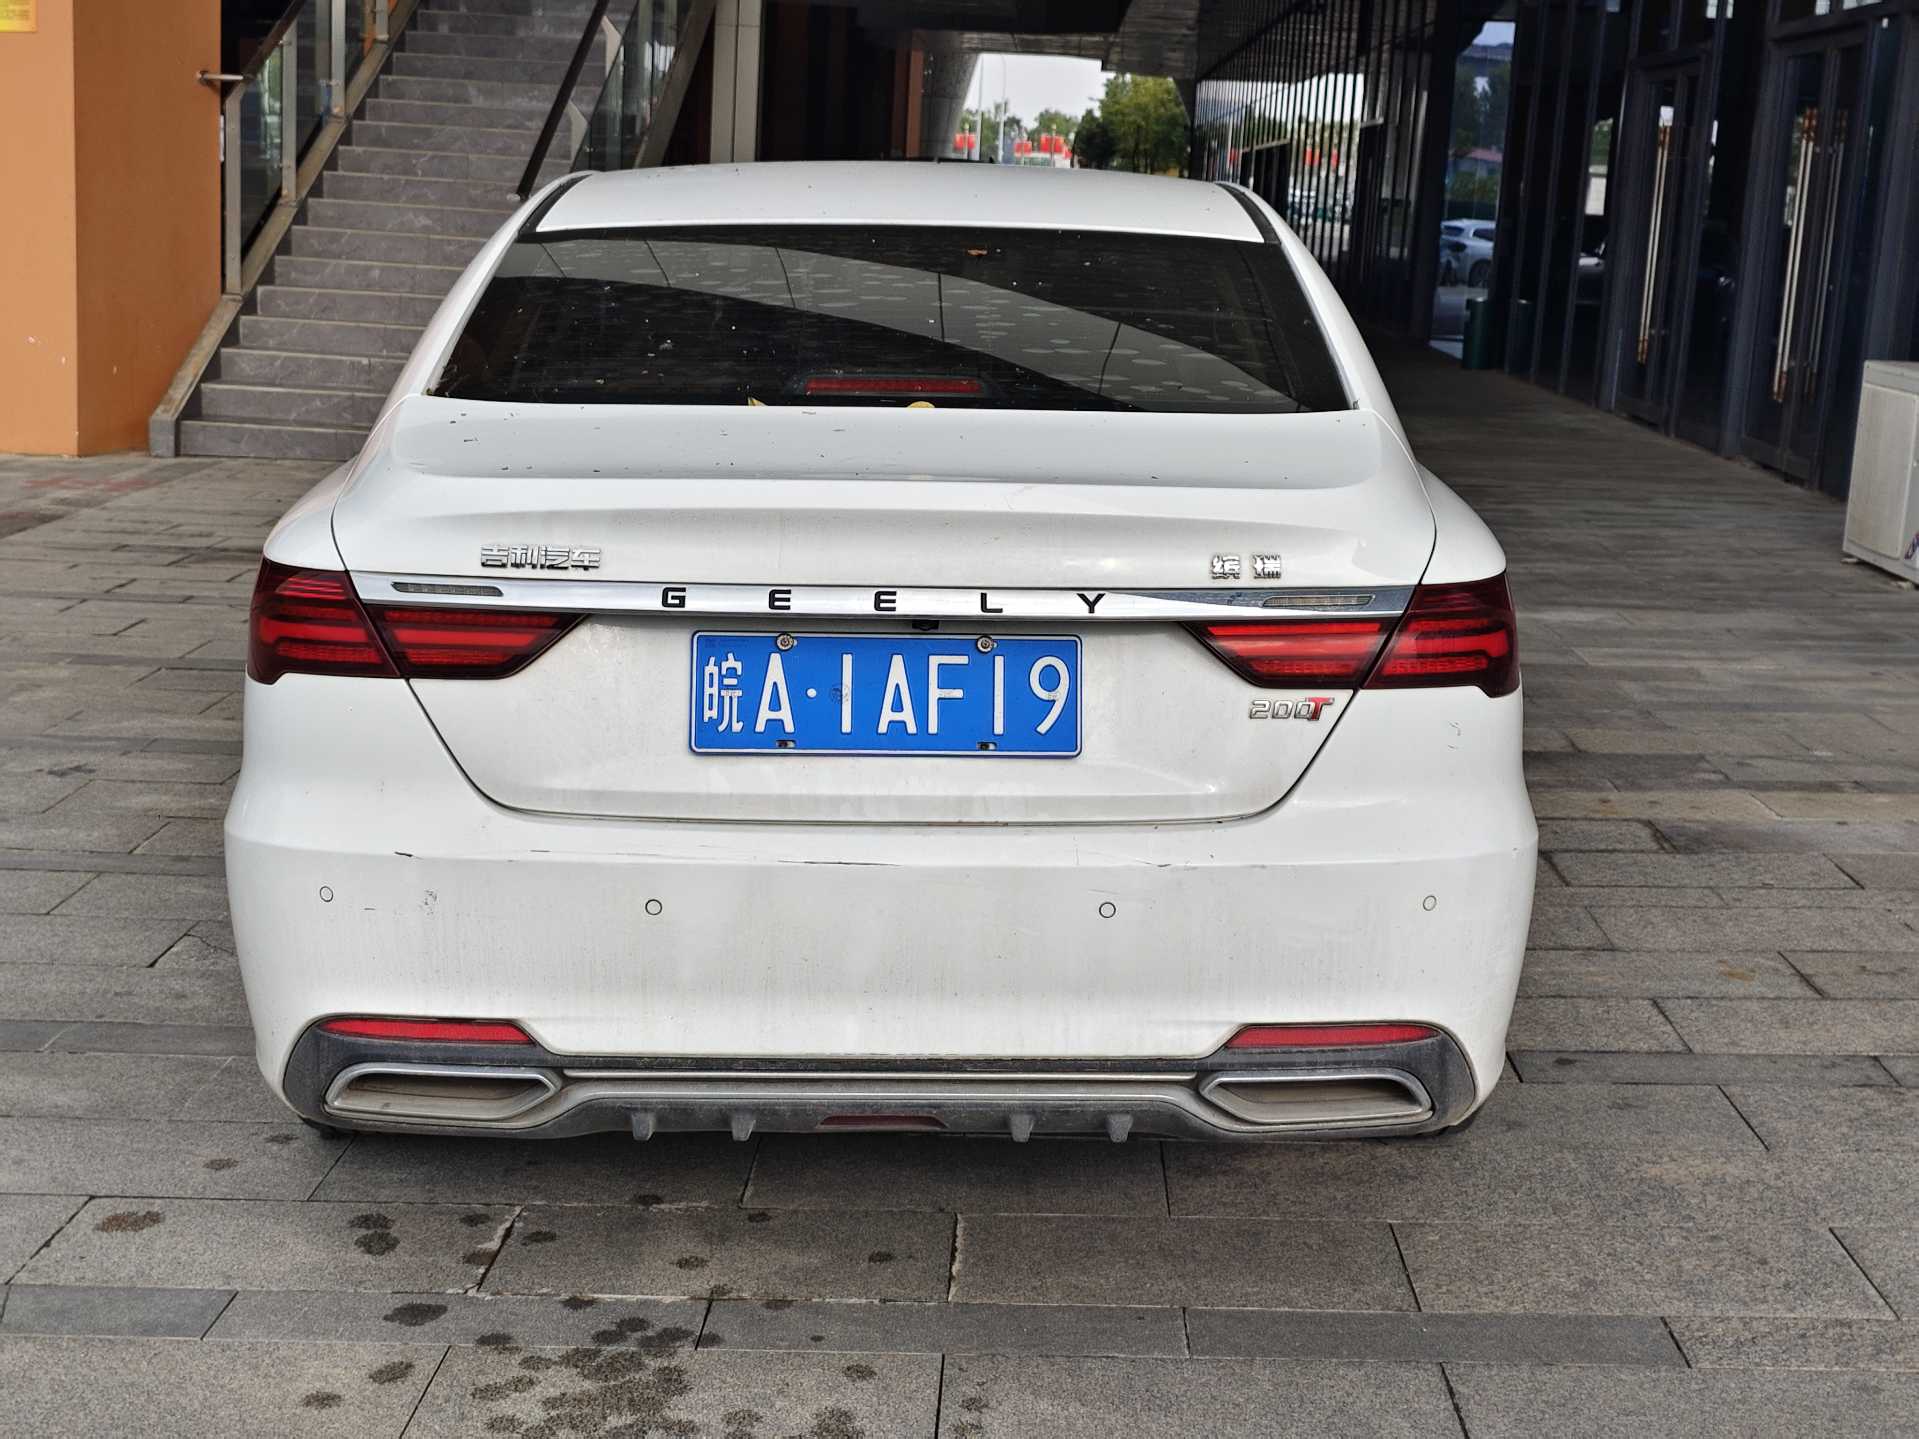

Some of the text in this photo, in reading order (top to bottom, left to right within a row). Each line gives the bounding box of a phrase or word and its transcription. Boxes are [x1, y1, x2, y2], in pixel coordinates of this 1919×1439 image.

[481, 544, 600, 570] 吉利汽车
[661, 586, 1106, 613] GEELY
[1249, 697, 1334, 721] 200T
